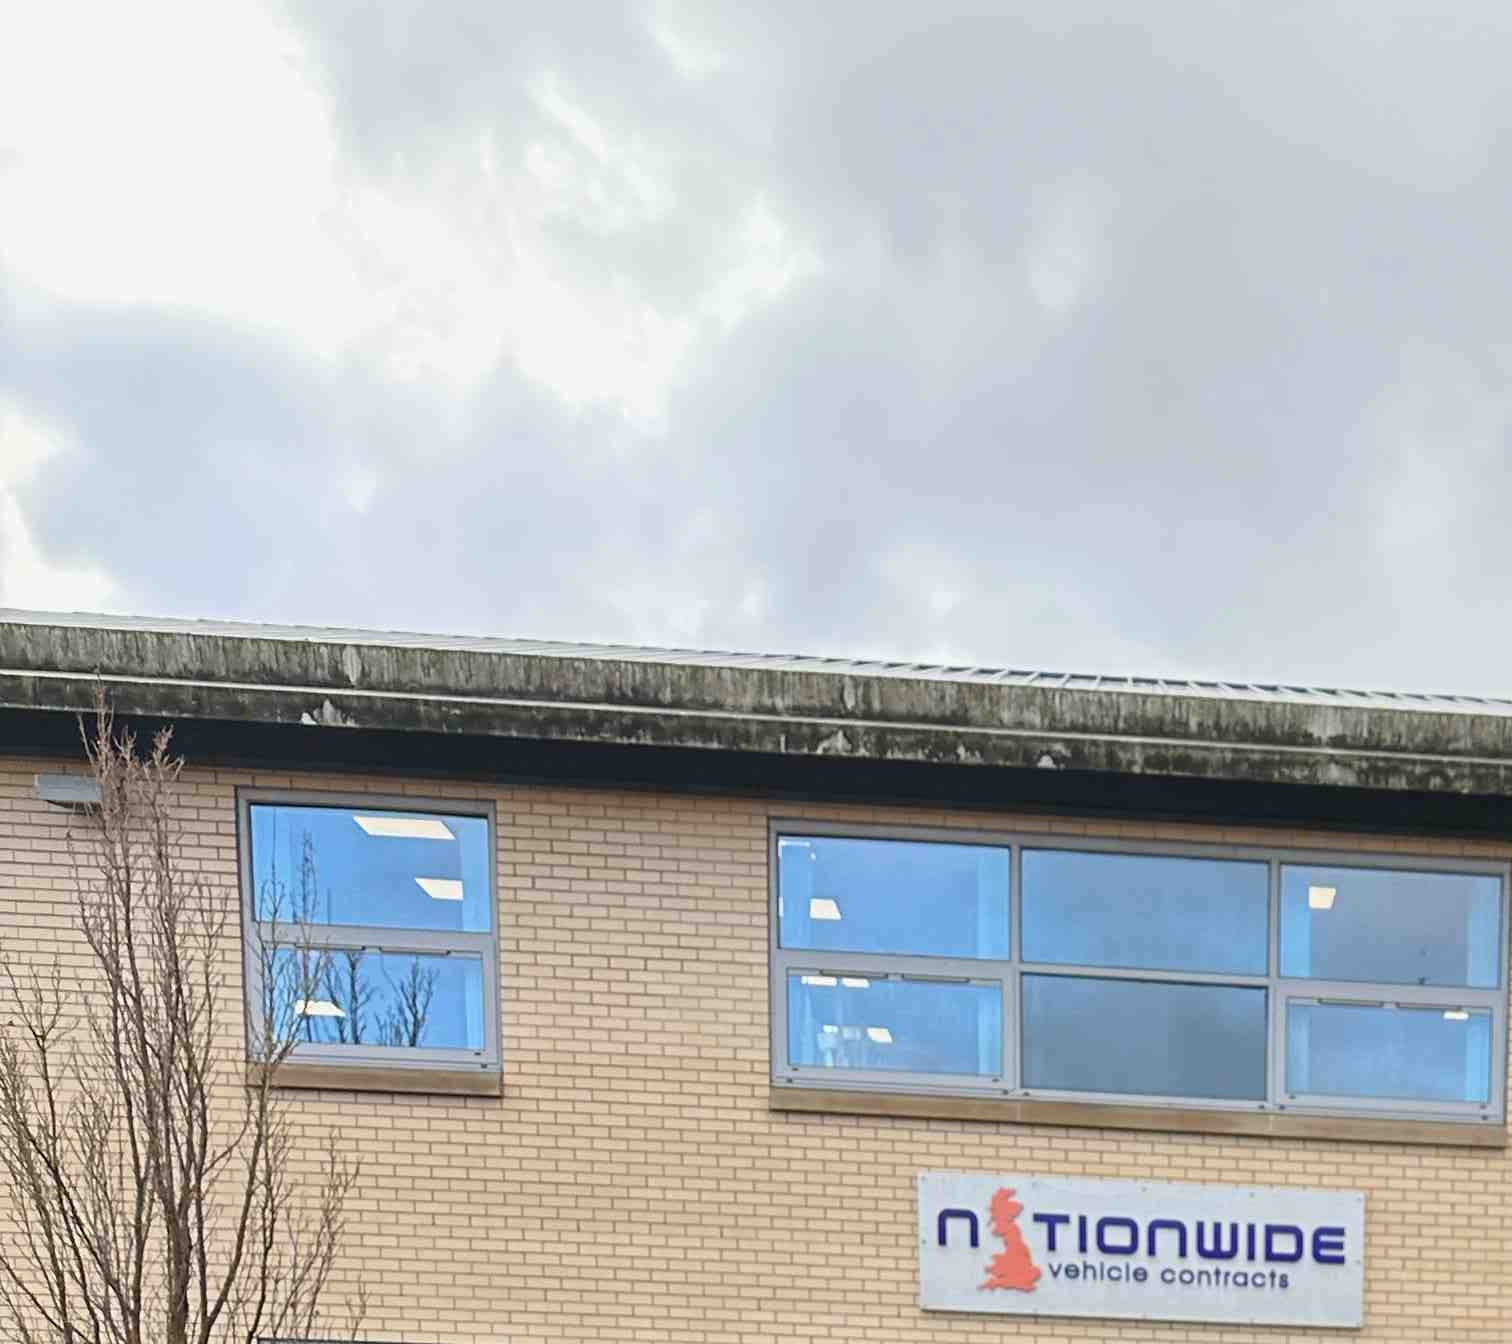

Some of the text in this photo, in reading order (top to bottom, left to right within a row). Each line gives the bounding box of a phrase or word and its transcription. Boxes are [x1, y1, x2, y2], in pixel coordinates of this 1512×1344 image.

[937, 1207, 1346, 1265] NTIONWIDE
[1048, 1261, 1290, 1290] vehicle contracts
